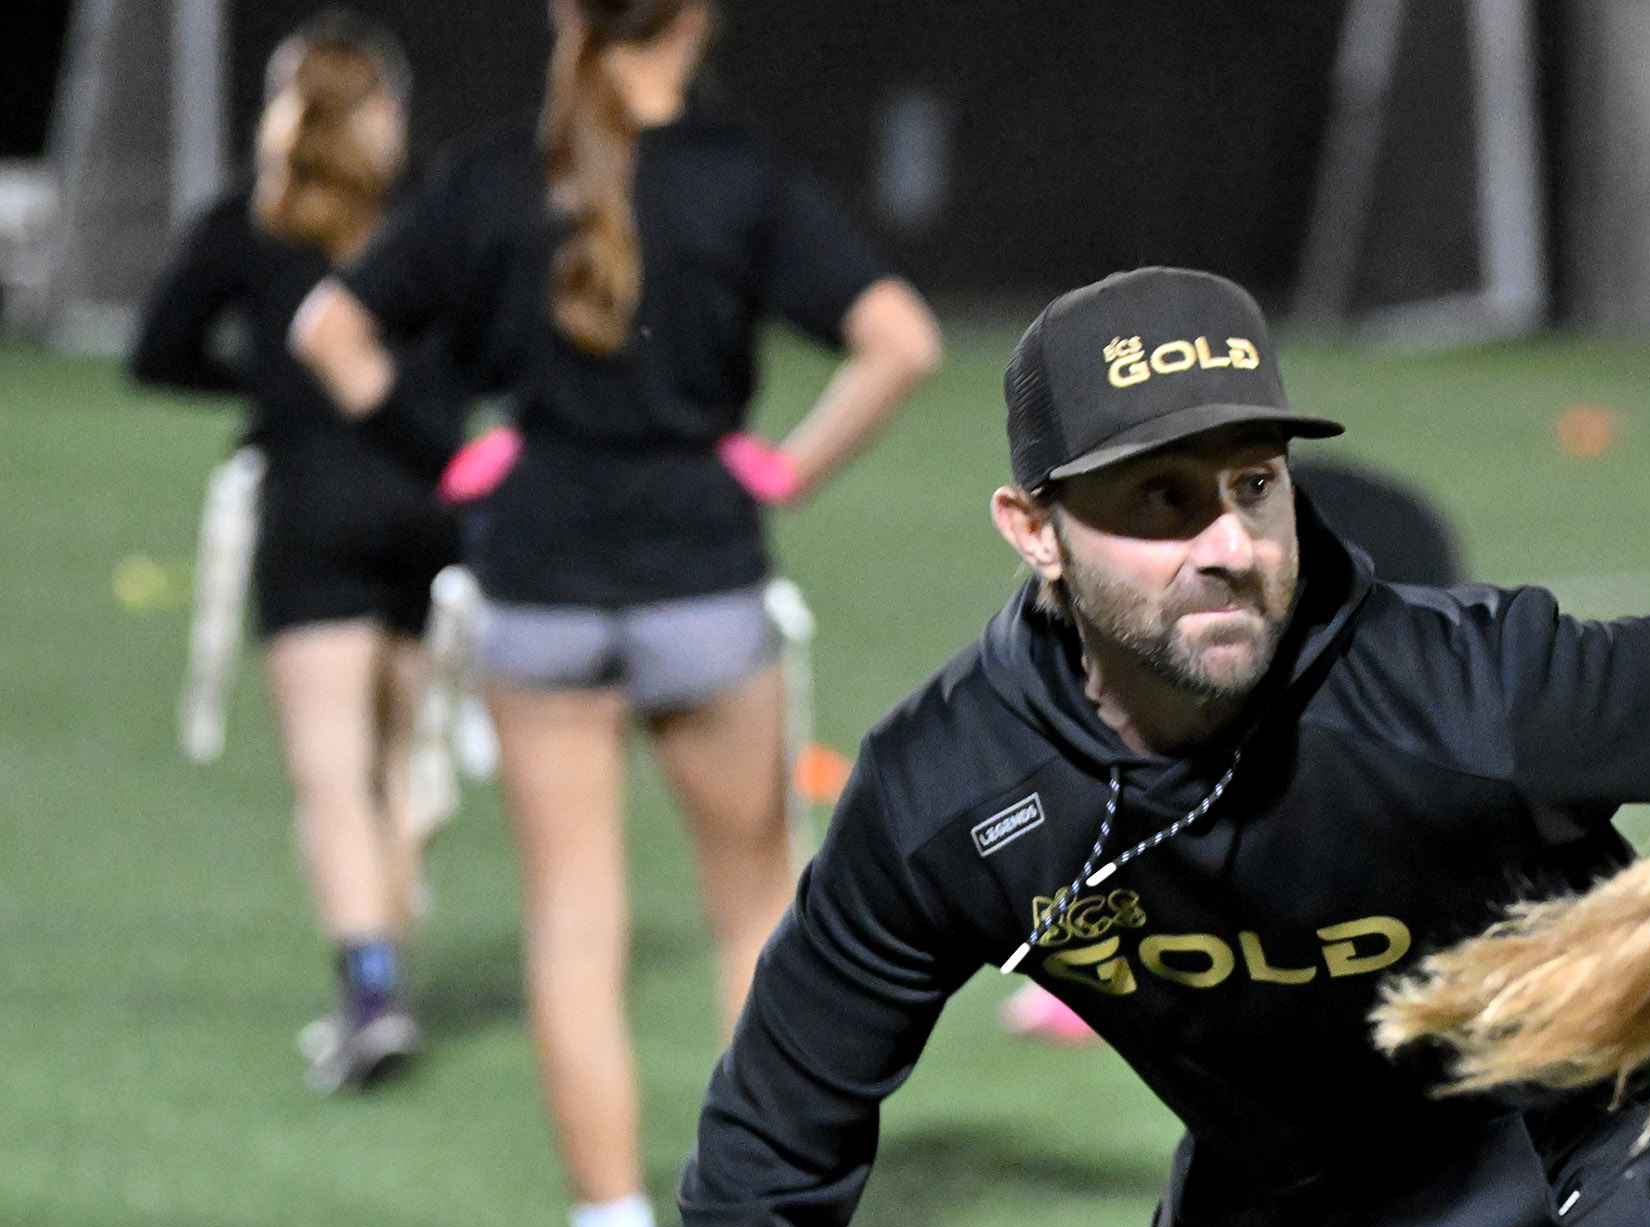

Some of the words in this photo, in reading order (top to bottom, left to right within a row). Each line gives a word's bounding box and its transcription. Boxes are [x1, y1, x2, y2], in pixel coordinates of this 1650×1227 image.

[1108, 336, 1261, 389] GOLD
[978, 804, 1038, 847] LEGENDS
[1042, 915, 1412, 996] GOLD
